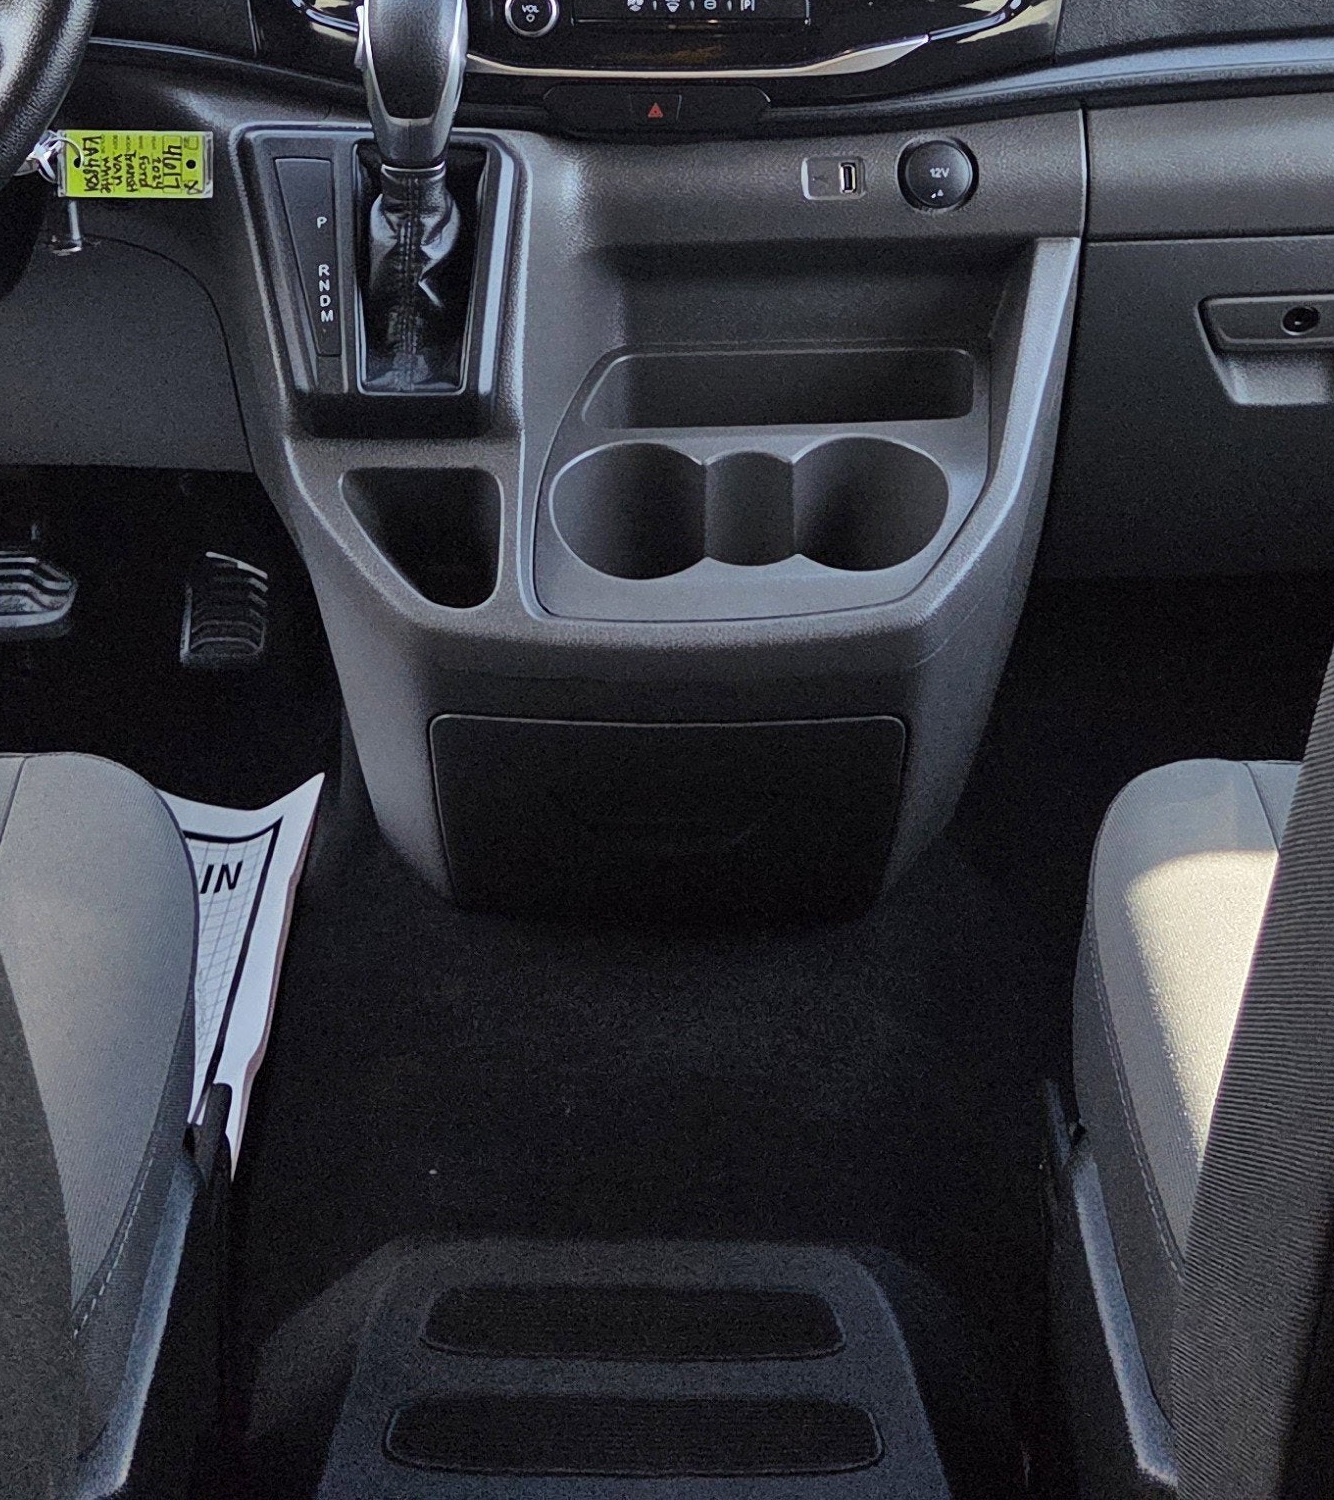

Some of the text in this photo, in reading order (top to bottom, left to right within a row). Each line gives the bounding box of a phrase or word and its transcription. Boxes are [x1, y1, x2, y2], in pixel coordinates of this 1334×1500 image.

[521, 4, 540, 14] VOL
[152, 156, 164, 190] 2024
[162, 144, 183, 190] 4617
[929, 167, 950, 179] 12V
[316, 216, 328, 229] P
[318, 263, 331, 277] R
[318, 278, 331, 292] N
[319, 294, 332, 308] D
[320, 309, 334, 323] M
[199, 860, 244, 895] IN
